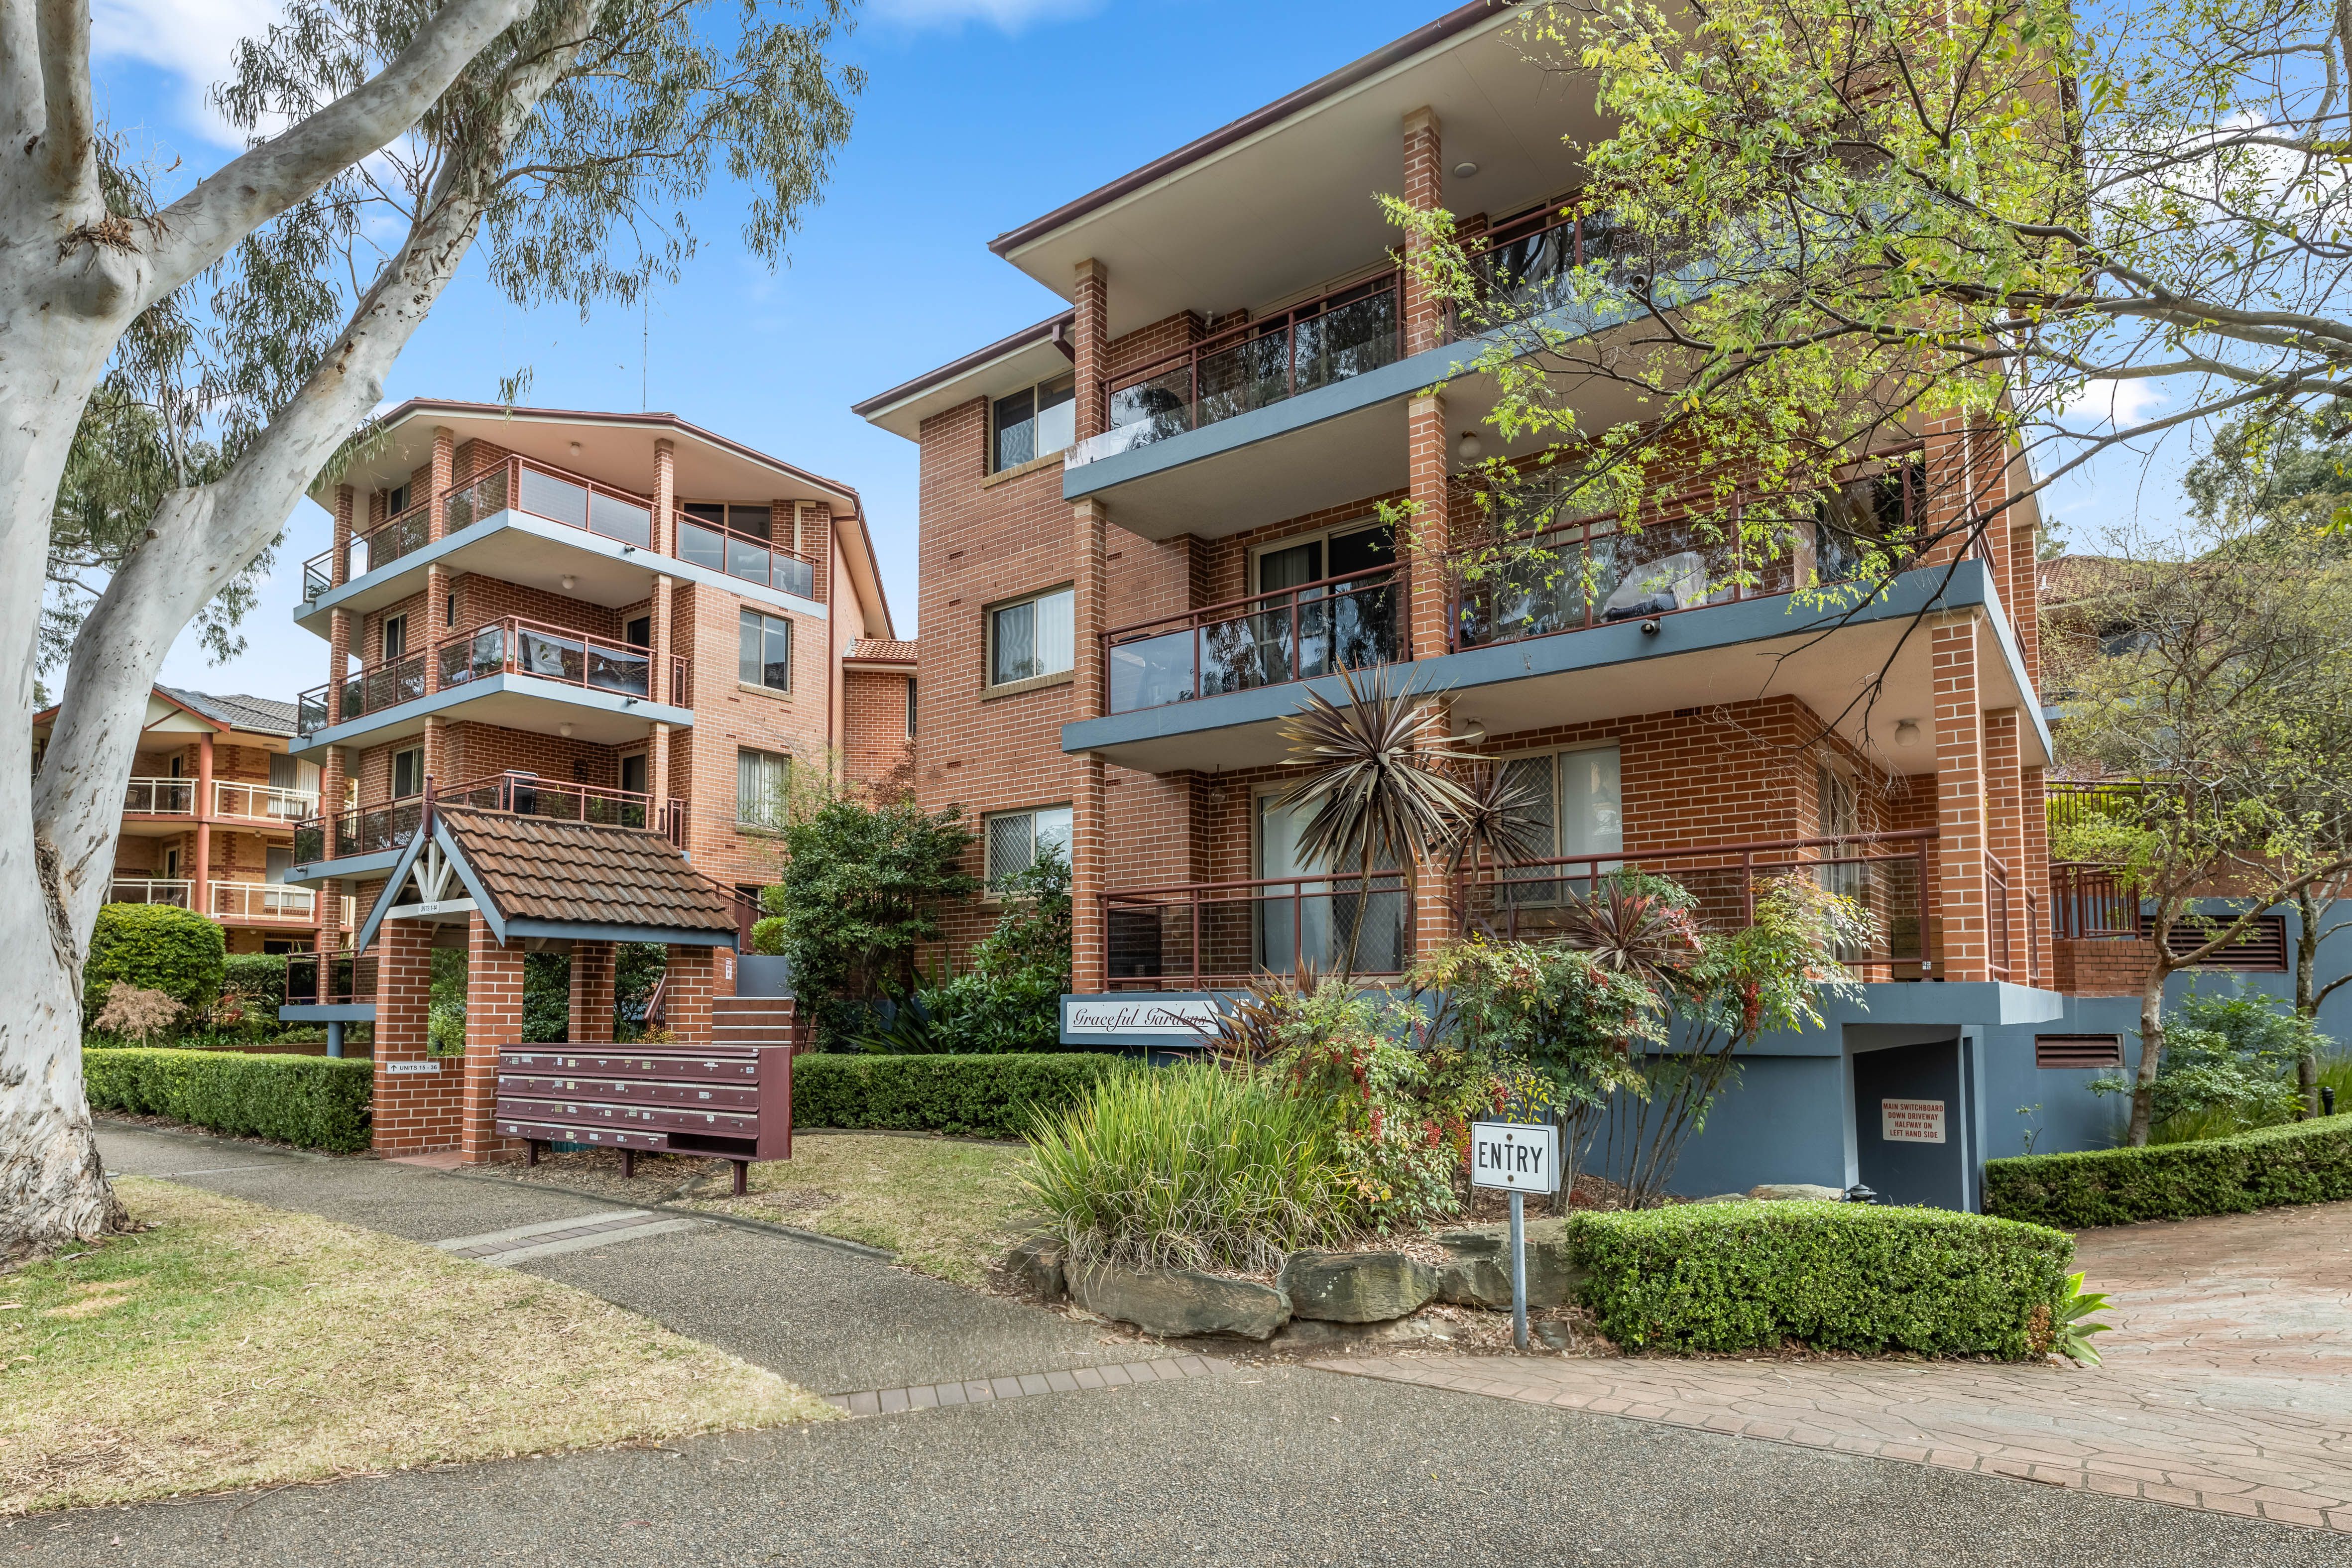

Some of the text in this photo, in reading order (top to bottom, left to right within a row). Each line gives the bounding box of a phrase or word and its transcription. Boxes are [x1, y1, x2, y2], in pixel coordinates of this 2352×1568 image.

[1073, 1007, 1140, 1032] Graceful
[1144, 1007, 1206, 1025] Gardens
[1900, 1103, 1943, 1112] SWITCHBOARD
[1479, 1141, 1543, 1174] ENTRY
